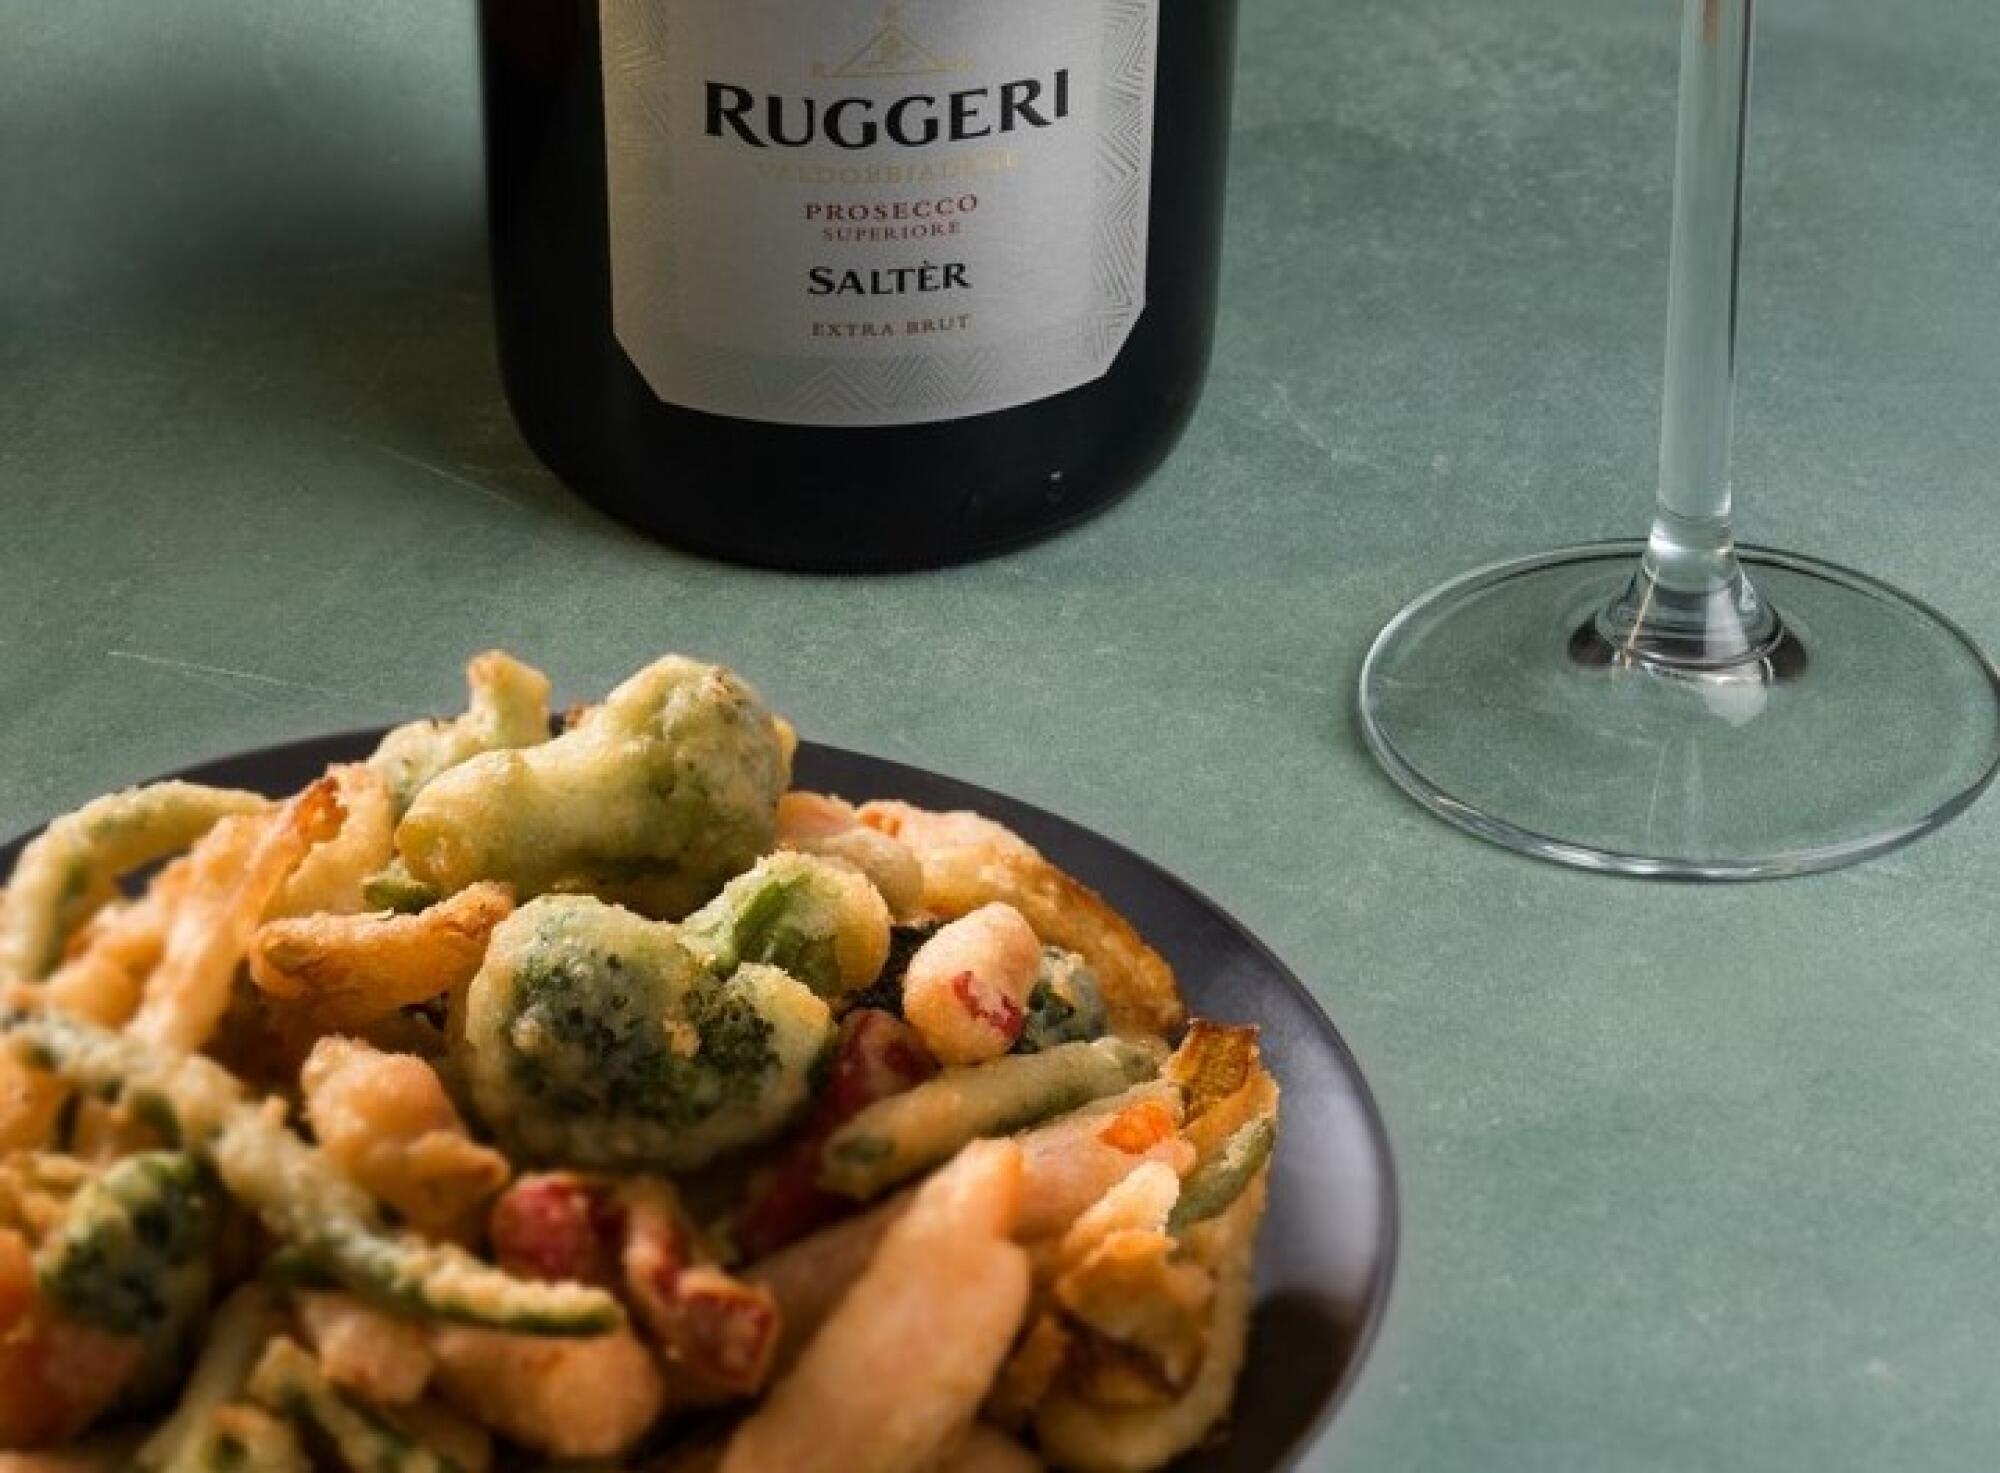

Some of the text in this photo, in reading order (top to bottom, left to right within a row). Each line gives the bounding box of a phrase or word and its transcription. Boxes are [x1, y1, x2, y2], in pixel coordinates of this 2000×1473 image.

[704, 68, 1069, 149] RUGGERI
[804, 193, 978, 221] PROSECCO
[822, 221, 961, 242] SUPERIORE
[806, 258, 973, 296] SALTÈR
[811, 313, 971, 338] EXTRA BRUT
